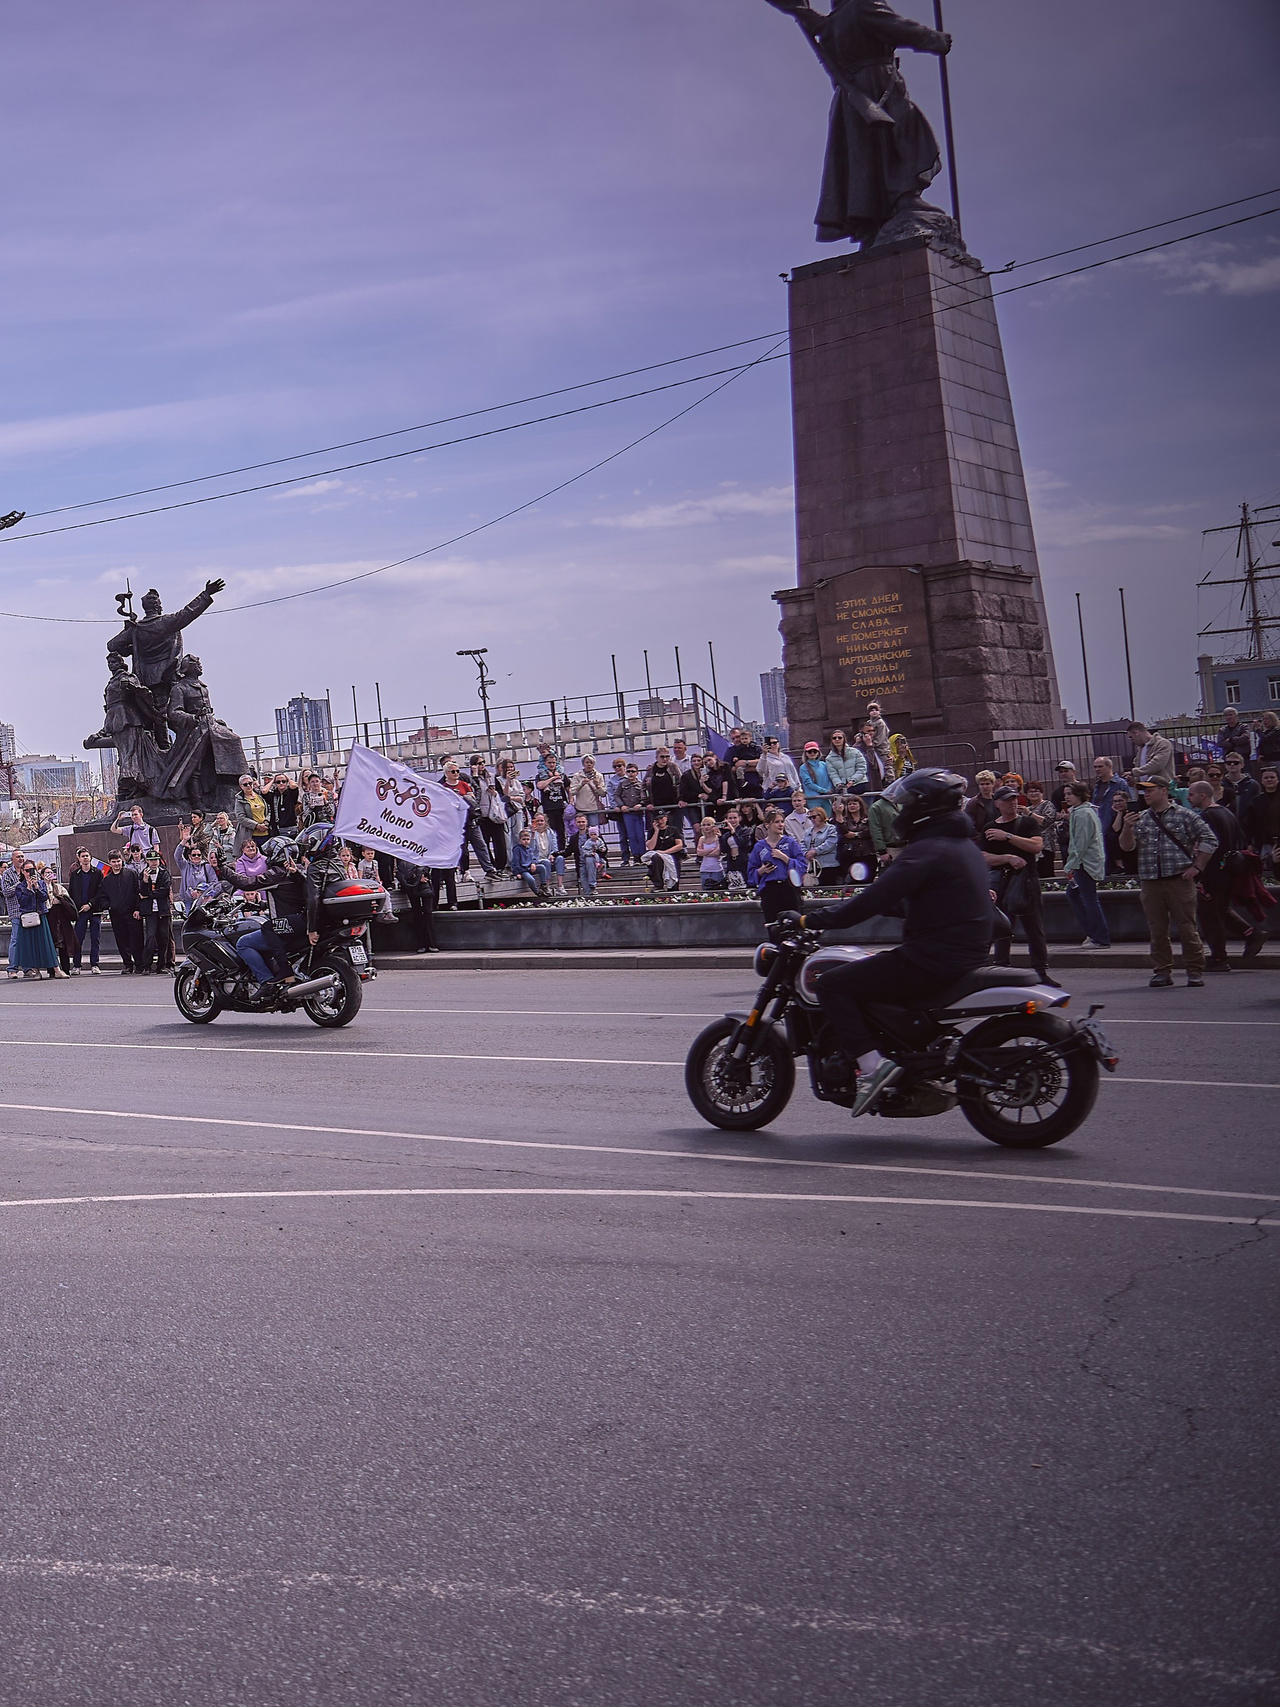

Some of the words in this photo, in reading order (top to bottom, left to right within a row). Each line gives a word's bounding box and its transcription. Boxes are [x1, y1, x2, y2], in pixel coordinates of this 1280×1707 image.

[871, 593, 899, 605] ДНЕЙ
[836, 611, 849, 621] НЕ
[851, 603, 904, 619] СМОЛКНЕТ
[836, 634, 849, 643] НЕ
[851, 625, 909, 641] ПОМЕРКНЕТ
[846, 639, 902, 653] НИКОГДА!
[838, 648, 912, 666] ПАРТИЗАНСКИЕ
[854, 662, 898, 675] ОТРЯДЫ
[850, 673, 905, 687] ЗАНИМАЛИ
[380, 807, 414, 830] Мото
[356, 817, 429, 857] Владивосток
